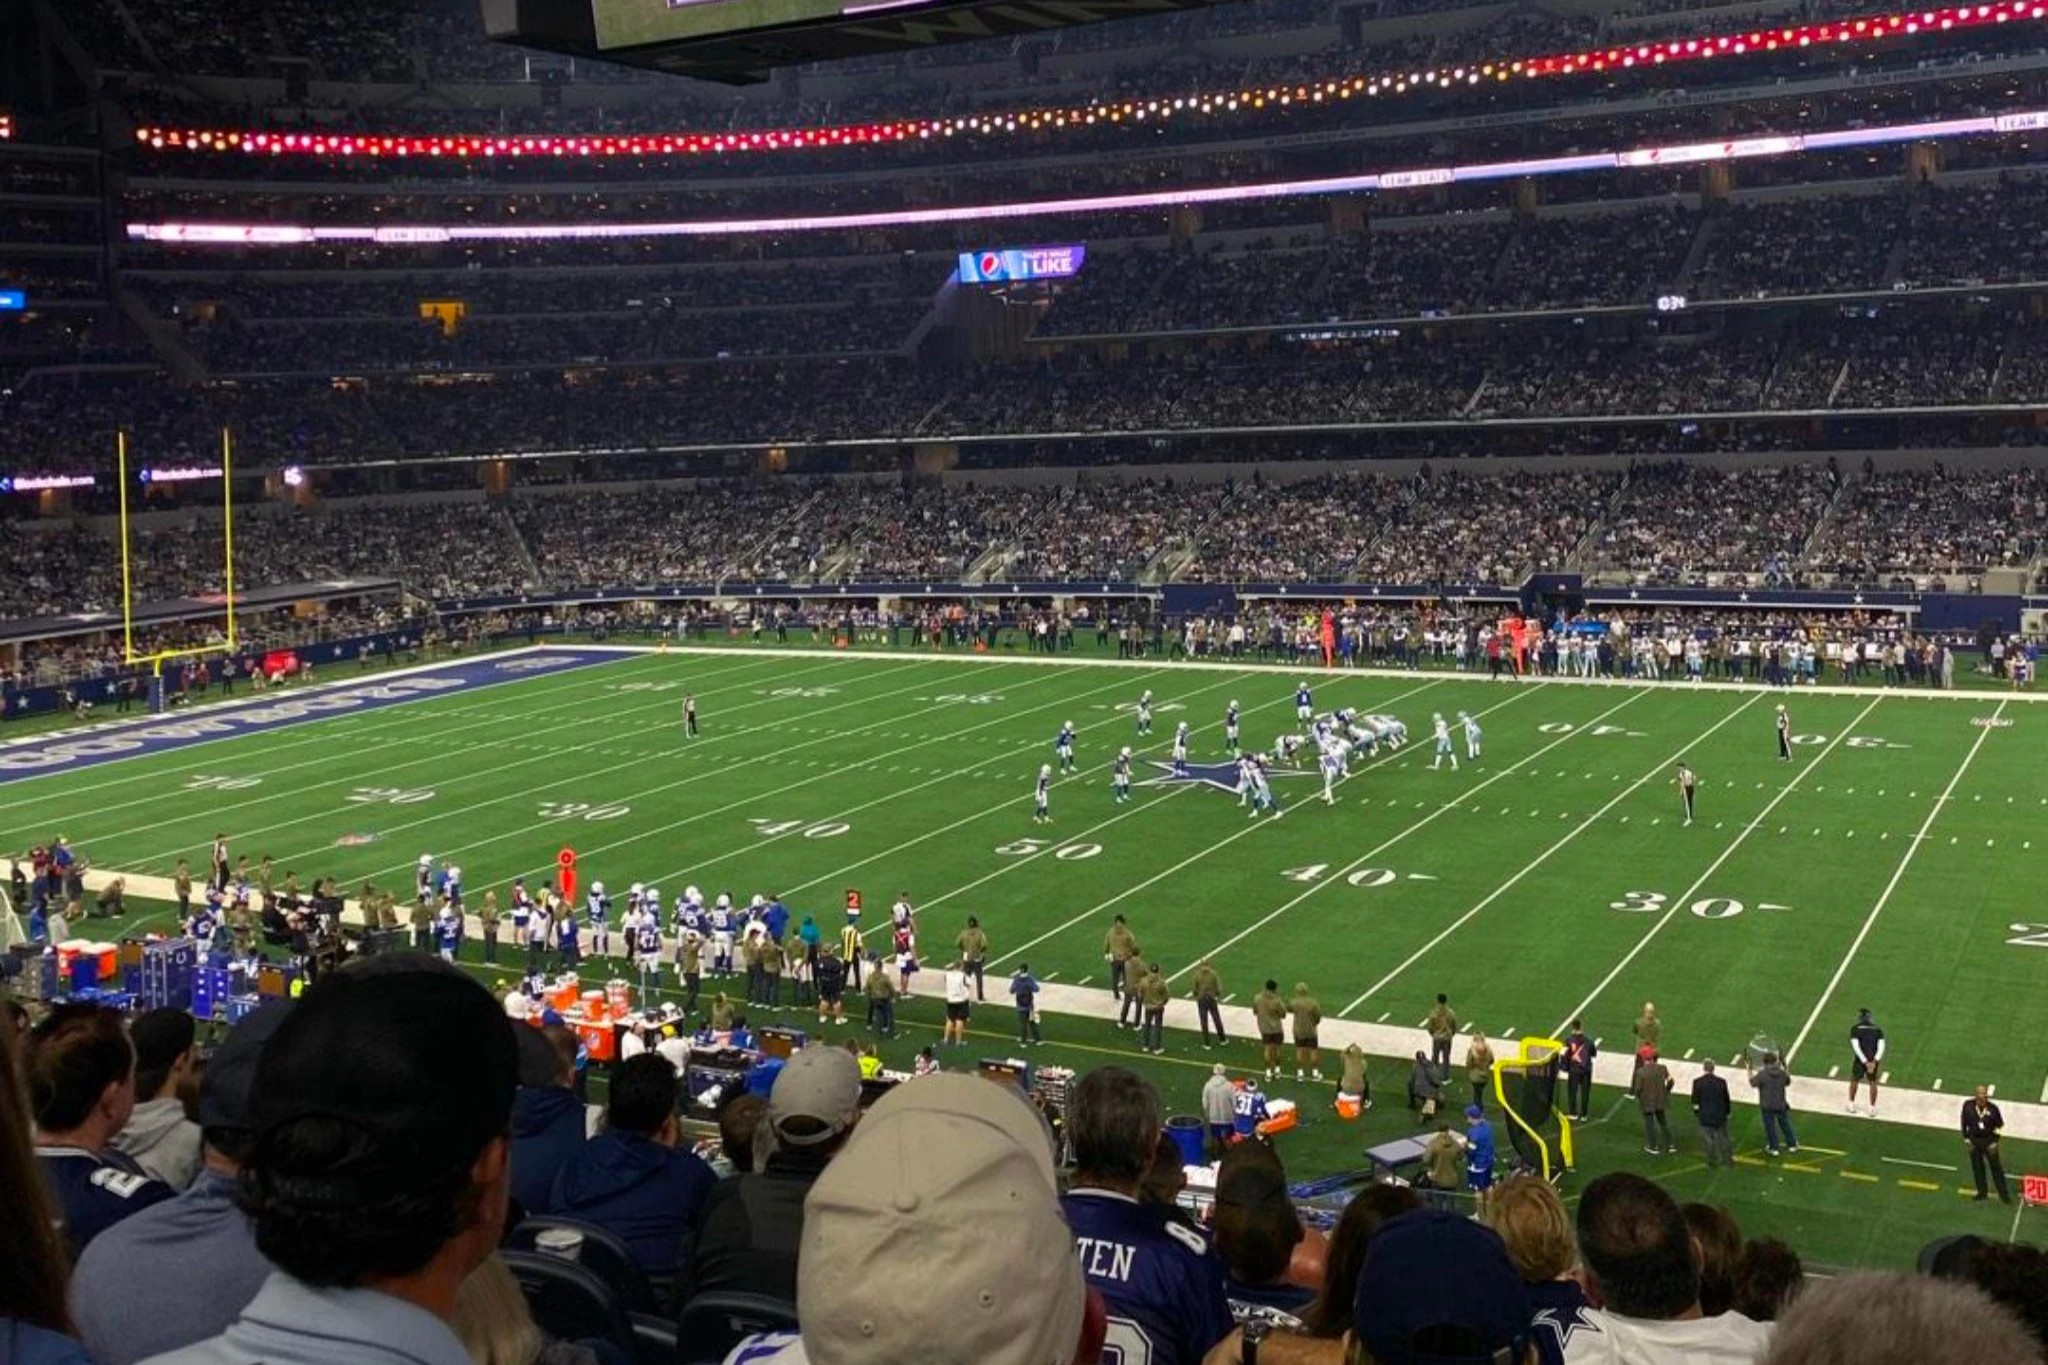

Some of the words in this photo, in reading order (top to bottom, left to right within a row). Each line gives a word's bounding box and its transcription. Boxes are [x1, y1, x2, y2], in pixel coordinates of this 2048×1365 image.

[1033, 257, 1072, 273] LIKE
[848, 891, 861, 906] 2
[2026, 1178, 2047, 1200] 20
